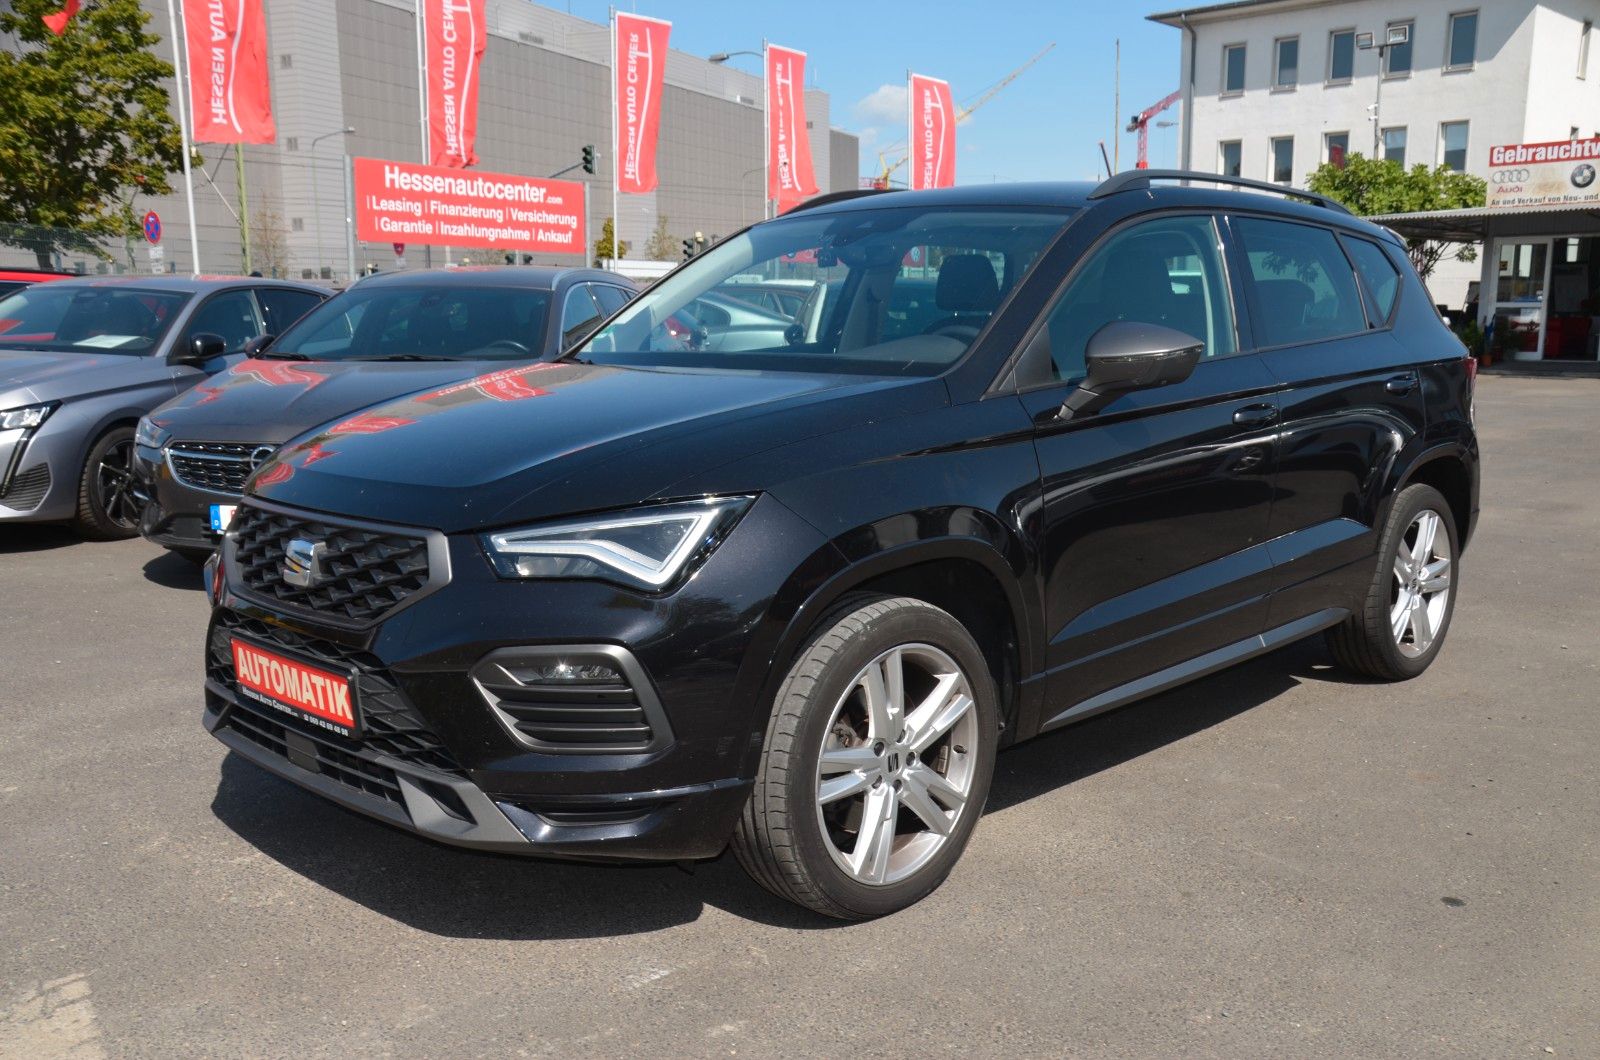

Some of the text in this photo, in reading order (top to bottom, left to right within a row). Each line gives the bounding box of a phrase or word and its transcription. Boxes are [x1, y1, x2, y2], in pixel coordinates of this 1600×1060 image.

[372, 196, 578, 229] Leasing Finanzierung Versicherung
[1517, 196, 1546, 204] Verkauf
[380, 217, 573, 244] Garantie Inzahlungnahme Ankauf
[237, 646, 354, 721] AUTOMATIK
